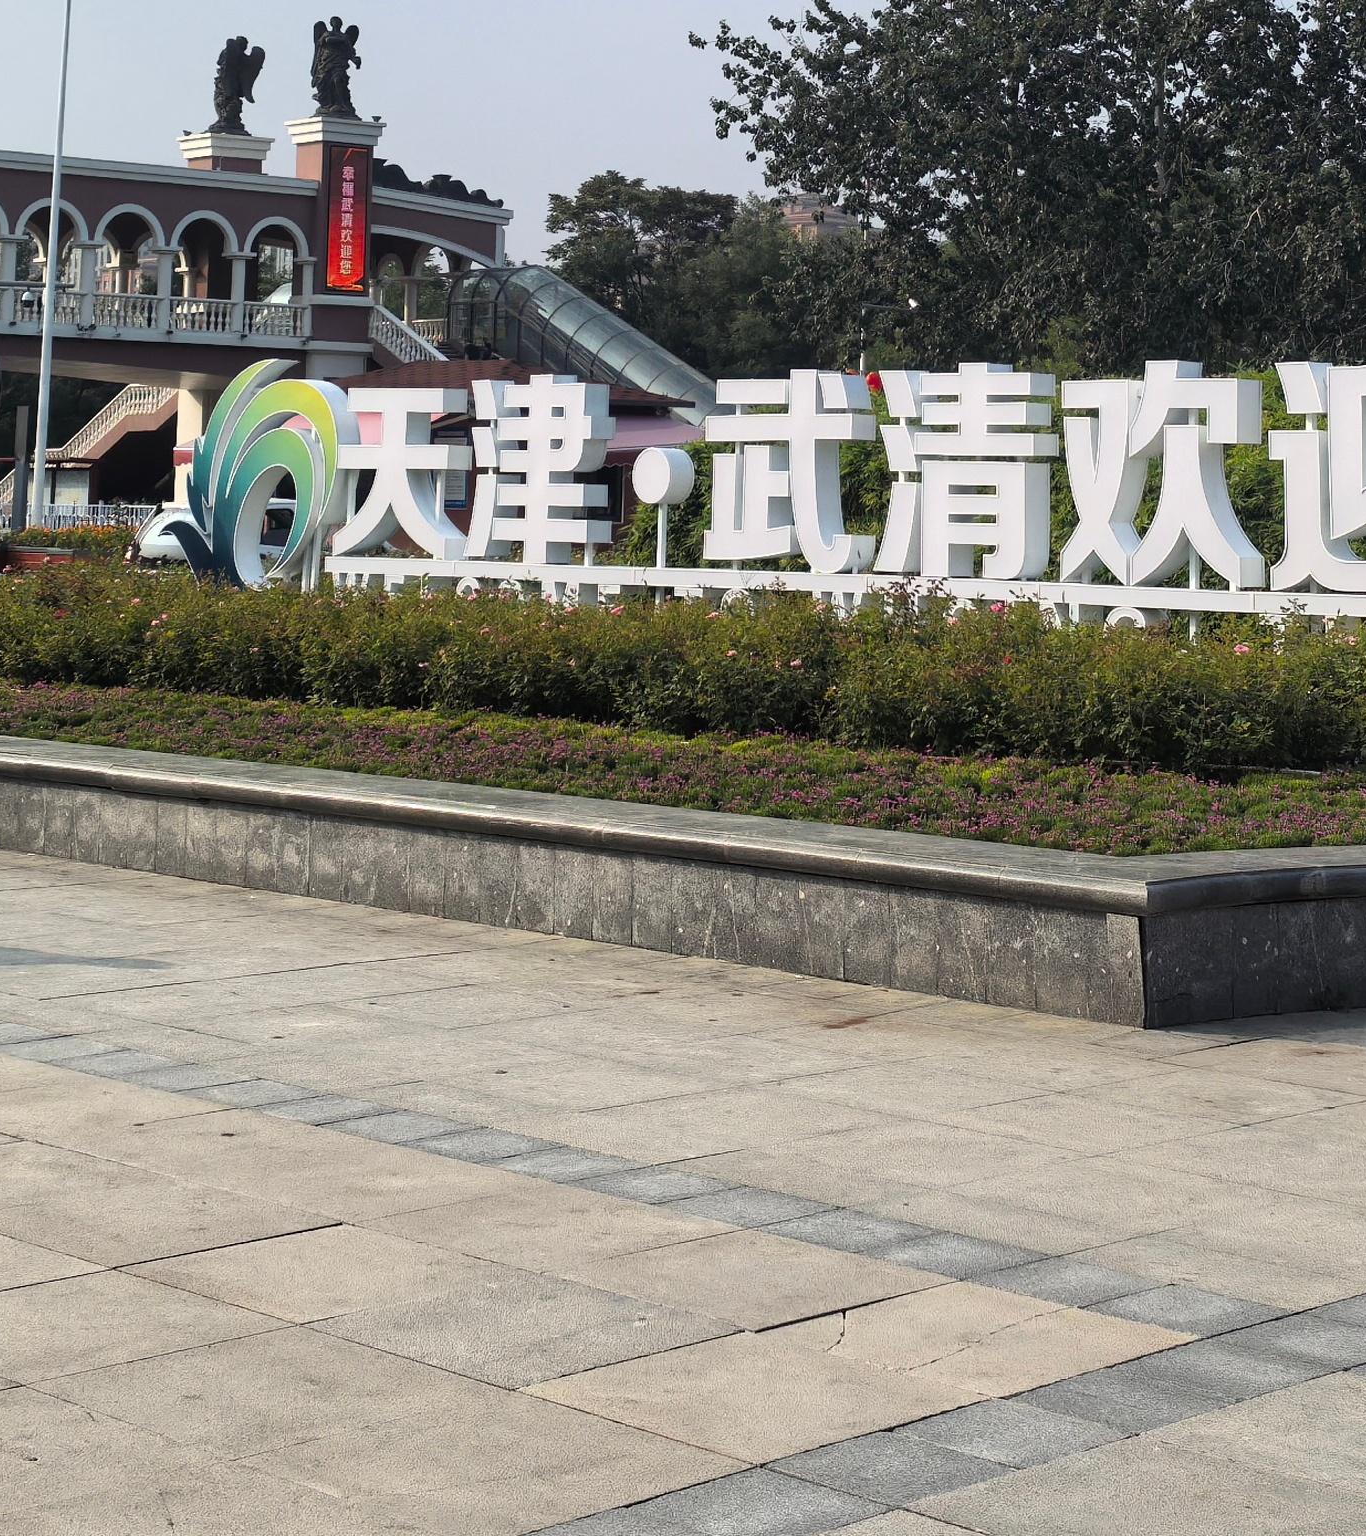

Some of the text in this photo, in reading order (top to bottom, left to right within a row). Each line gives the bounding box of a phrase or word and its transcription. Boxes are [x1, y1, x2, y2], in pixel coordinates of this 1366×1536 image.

[339, 166, 355, 275] 幸福武清欢迎您
